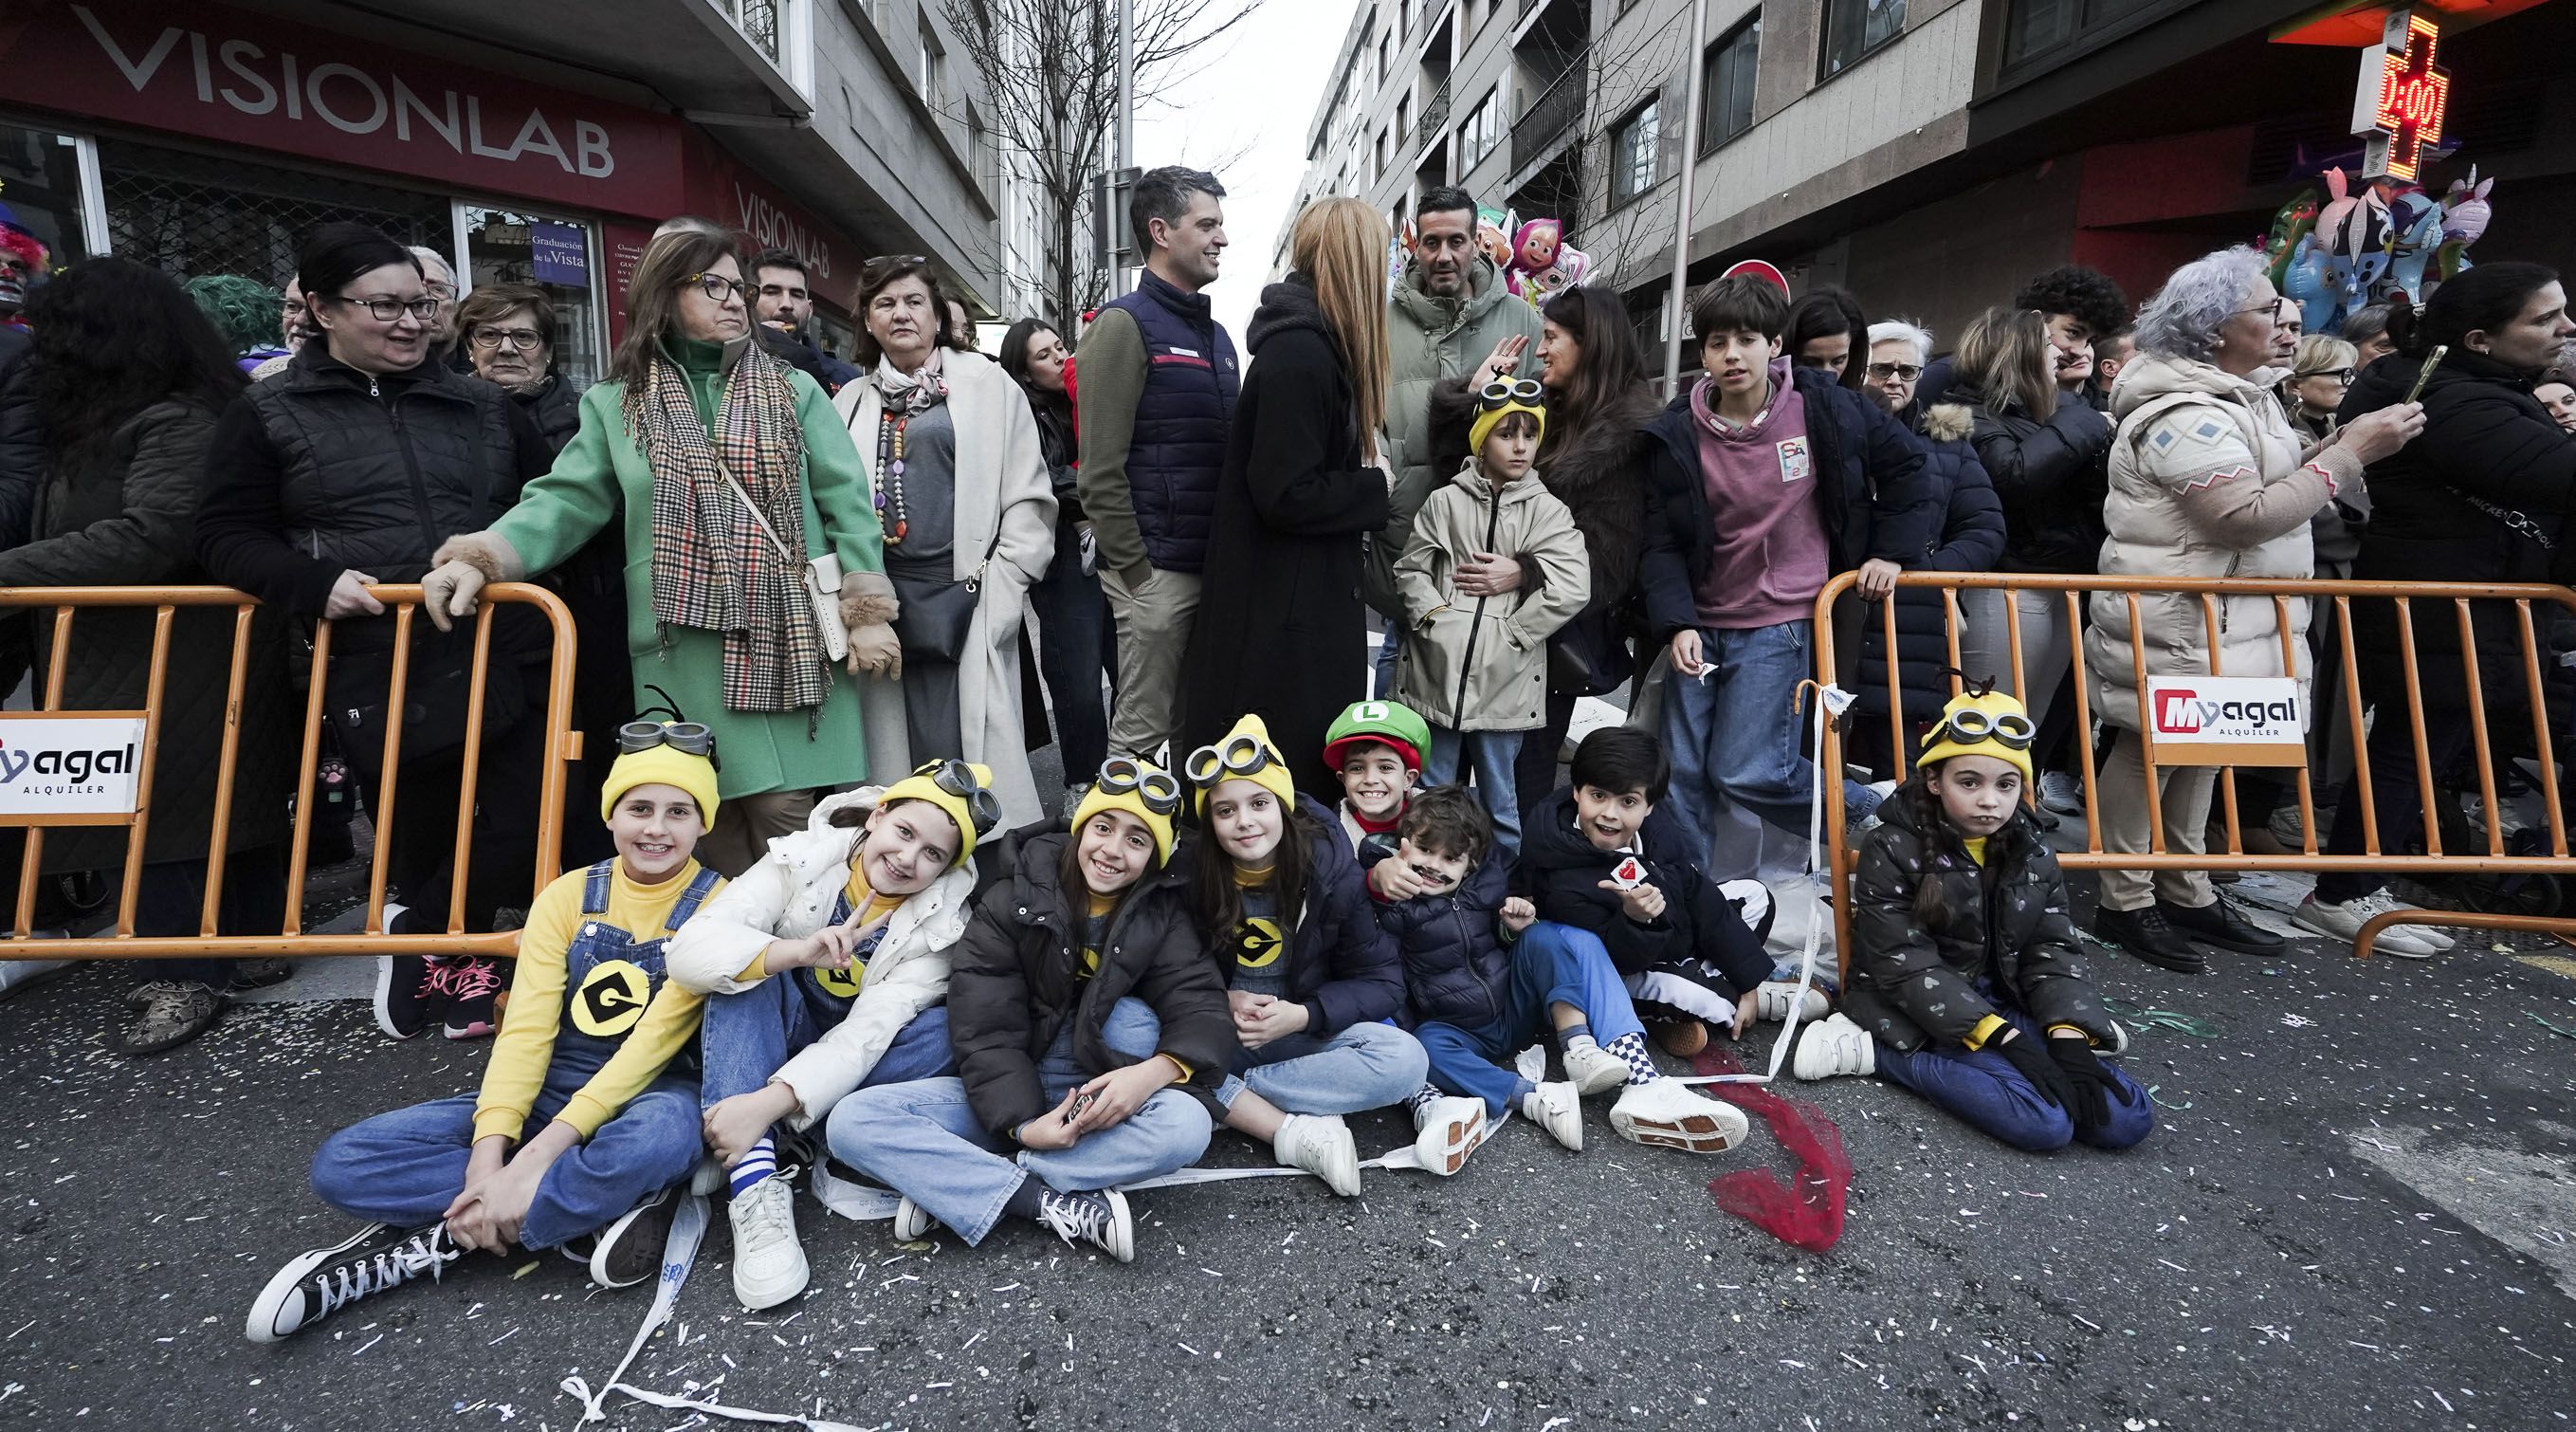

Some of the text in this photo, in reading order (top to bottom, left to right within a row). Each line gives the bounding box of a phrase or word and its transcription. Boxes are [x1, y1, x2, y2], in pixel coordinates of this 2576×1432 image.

[70, 3, 614, 178] VISIONLAB
[735, 181, 830, 279] VISIONLAB
[532, 235, 583, 250] Graduación
[534, 250, 584, 267] de la Vista
[1362, 705, 1379, 719] L
[2164, 697, 2296, 728] Myagal
[0, 743, 135, 784] yagal
[23, 785, 104, 796] ALQUILER
